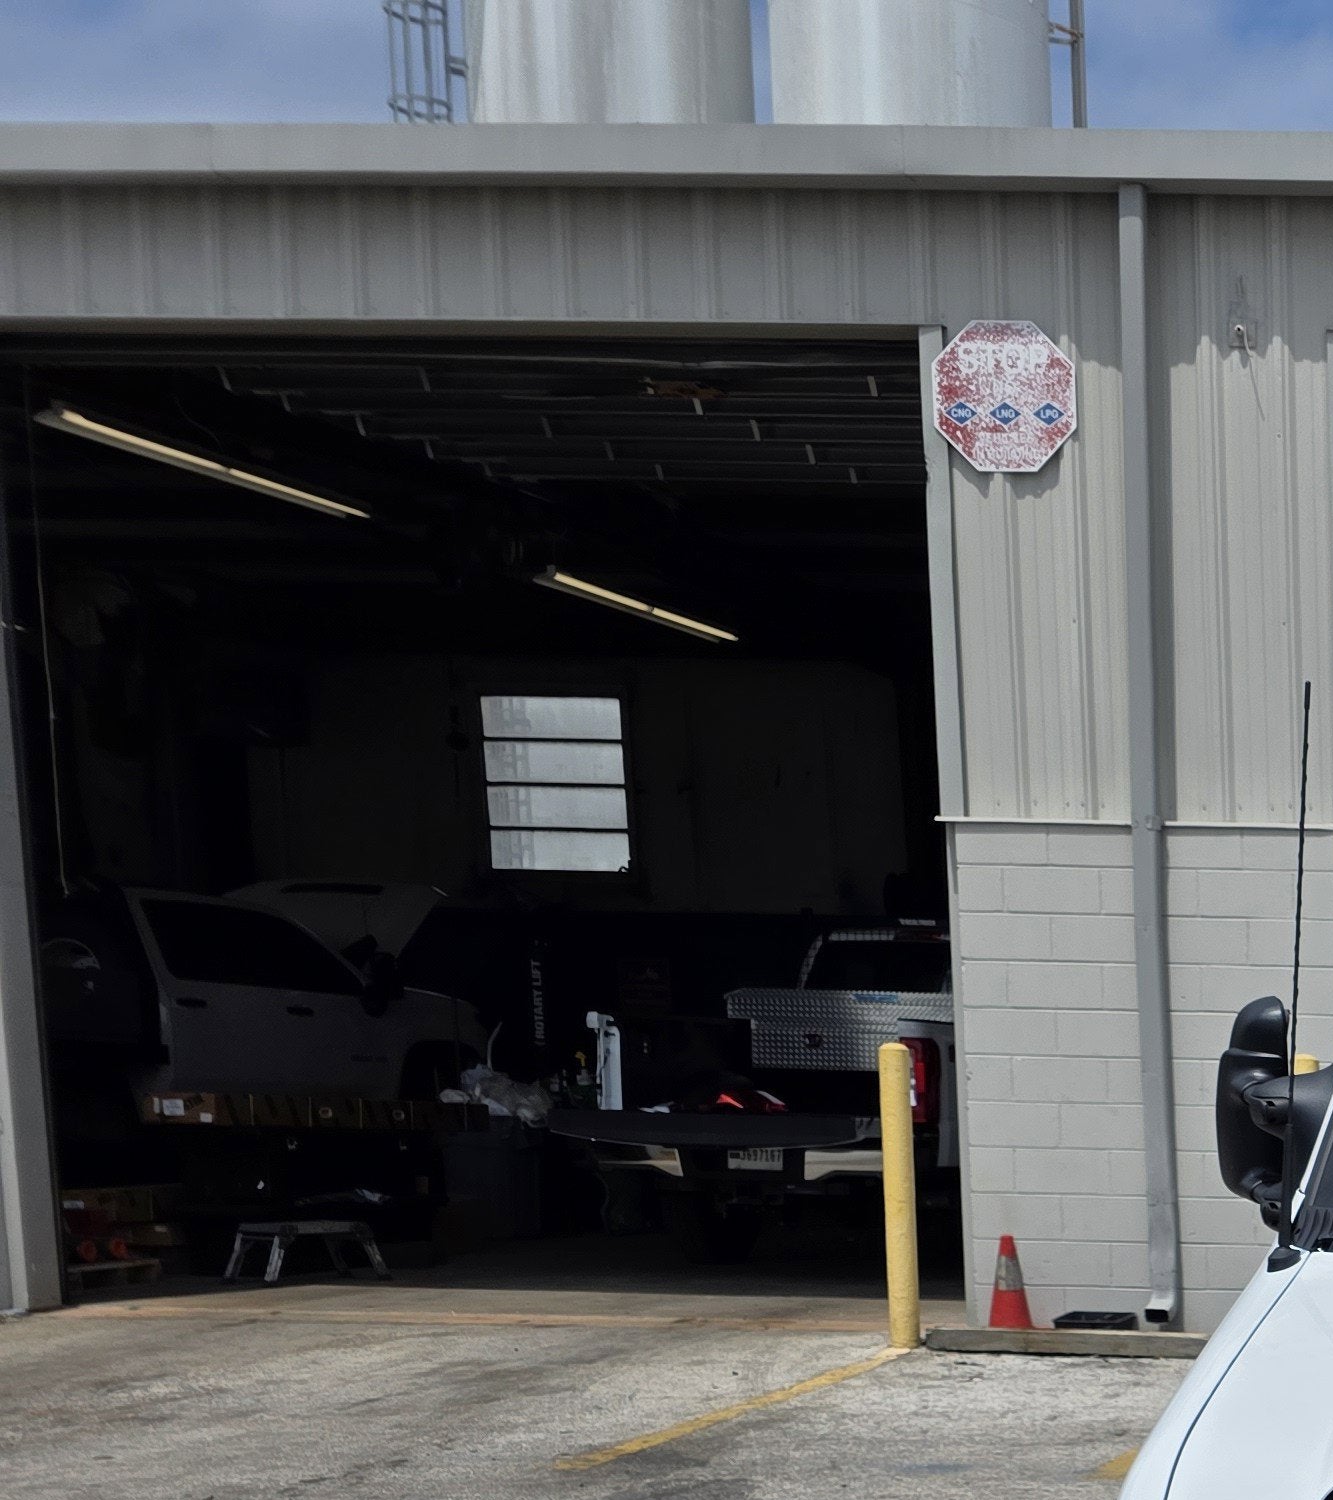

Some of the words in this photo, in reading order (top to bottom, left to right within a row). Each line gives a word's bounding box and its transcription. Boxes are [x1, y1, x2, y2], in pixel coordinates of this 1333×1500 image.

[957, 342, 1048, 374] STOP
[950, 407, 973, 419] CNG
[996, 407, 1016, 419] LNG
[1039, 408, 1059, 420] LPG
[530, 958, 542, 987] LIFT
[532, 988, 545, 1039] ROTARY
